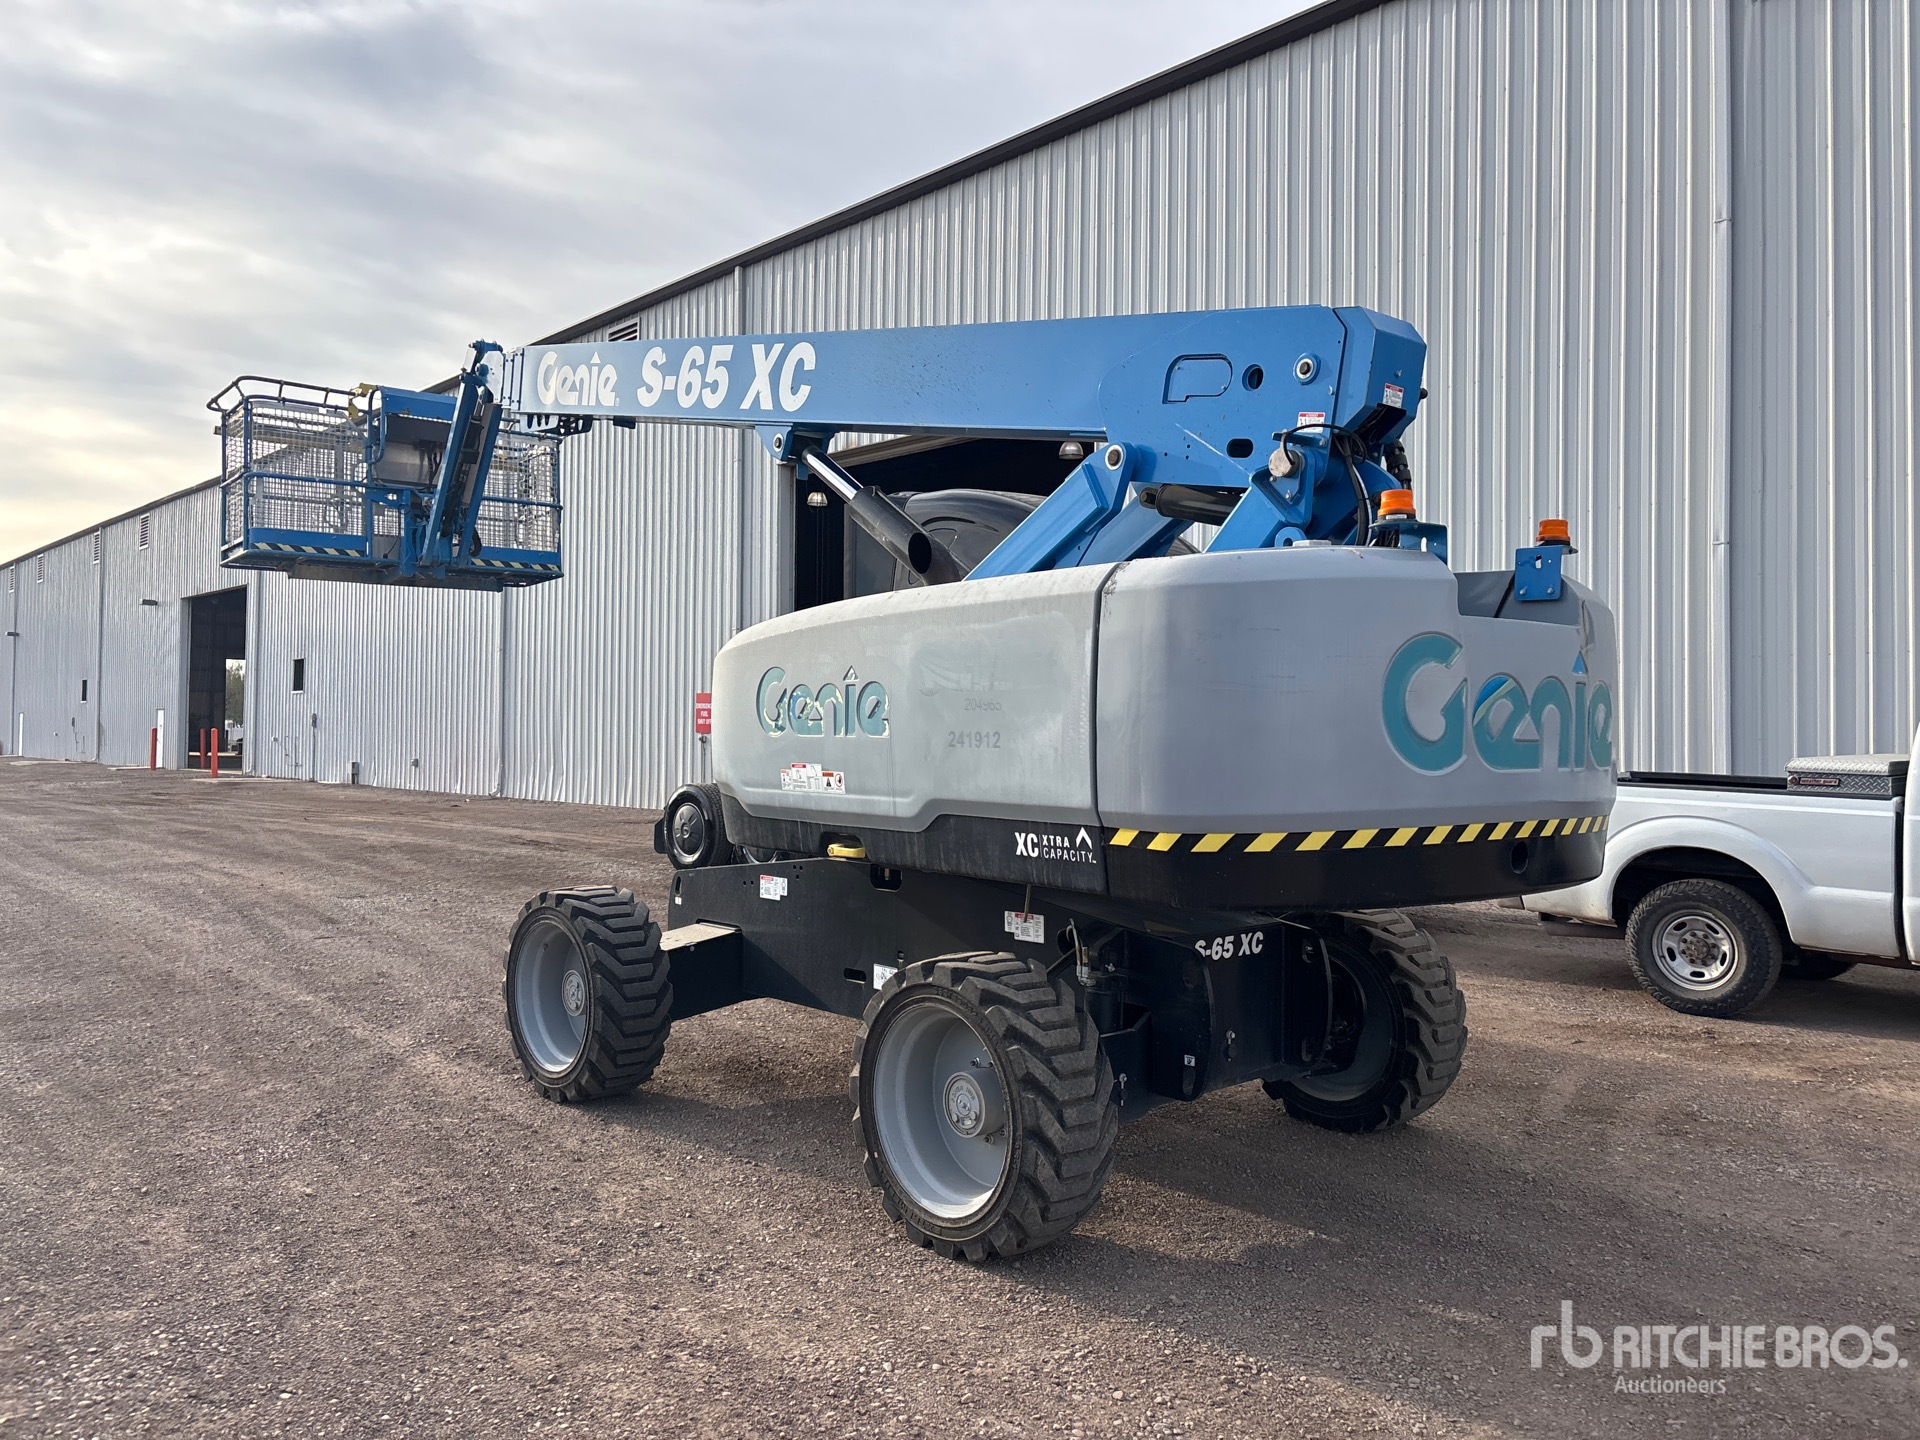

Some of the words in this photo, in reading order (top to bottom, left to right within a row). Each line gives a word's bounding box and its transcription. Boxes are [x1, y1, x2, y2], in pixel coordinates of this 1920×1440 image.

[537, 351, 618, 406] Genie
[637, 345, 734, 410] S-65
[739, 341, 816, 412] XC
[755, 665, 890, 738] Genie
[1382, 630, 1612, 776] Genie
[948, 731, 1001, 749] 241912
[1014, 832, 1039, 858] XC
[1042, 834, 1071, 848] XTRA
[1043, 847, 1093, 864] CAPACITY
[1194, 935, 1235, 961] S-65
[1238, 931, 1264, 956] XC
